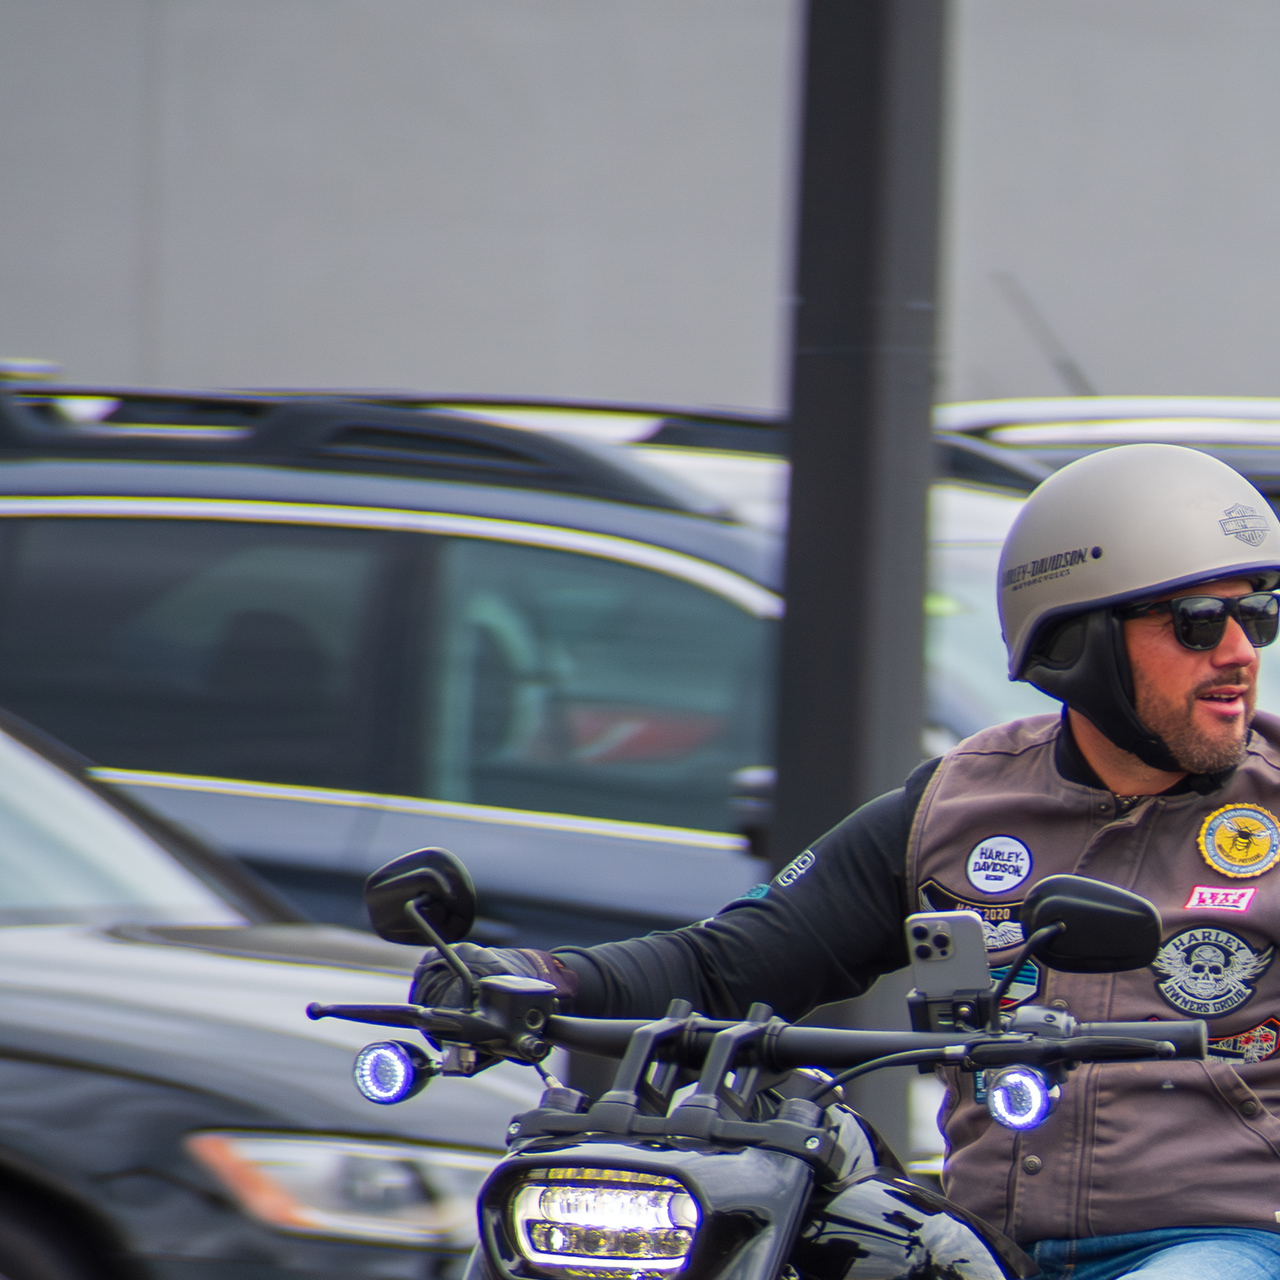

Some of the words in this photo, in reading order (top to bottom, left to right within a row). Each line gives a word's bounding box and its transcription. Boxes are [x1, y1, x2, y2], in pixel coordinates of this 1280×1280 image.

[979, 847, 1025, 863] HARLEY-
[984, 908, 1010, 920] 2020
[1172, 931, 1246, 952] HARLEY
[1164, 985, 1210, 1013] OWNERS
[1212, 988, 1248, 1012] GROUP
